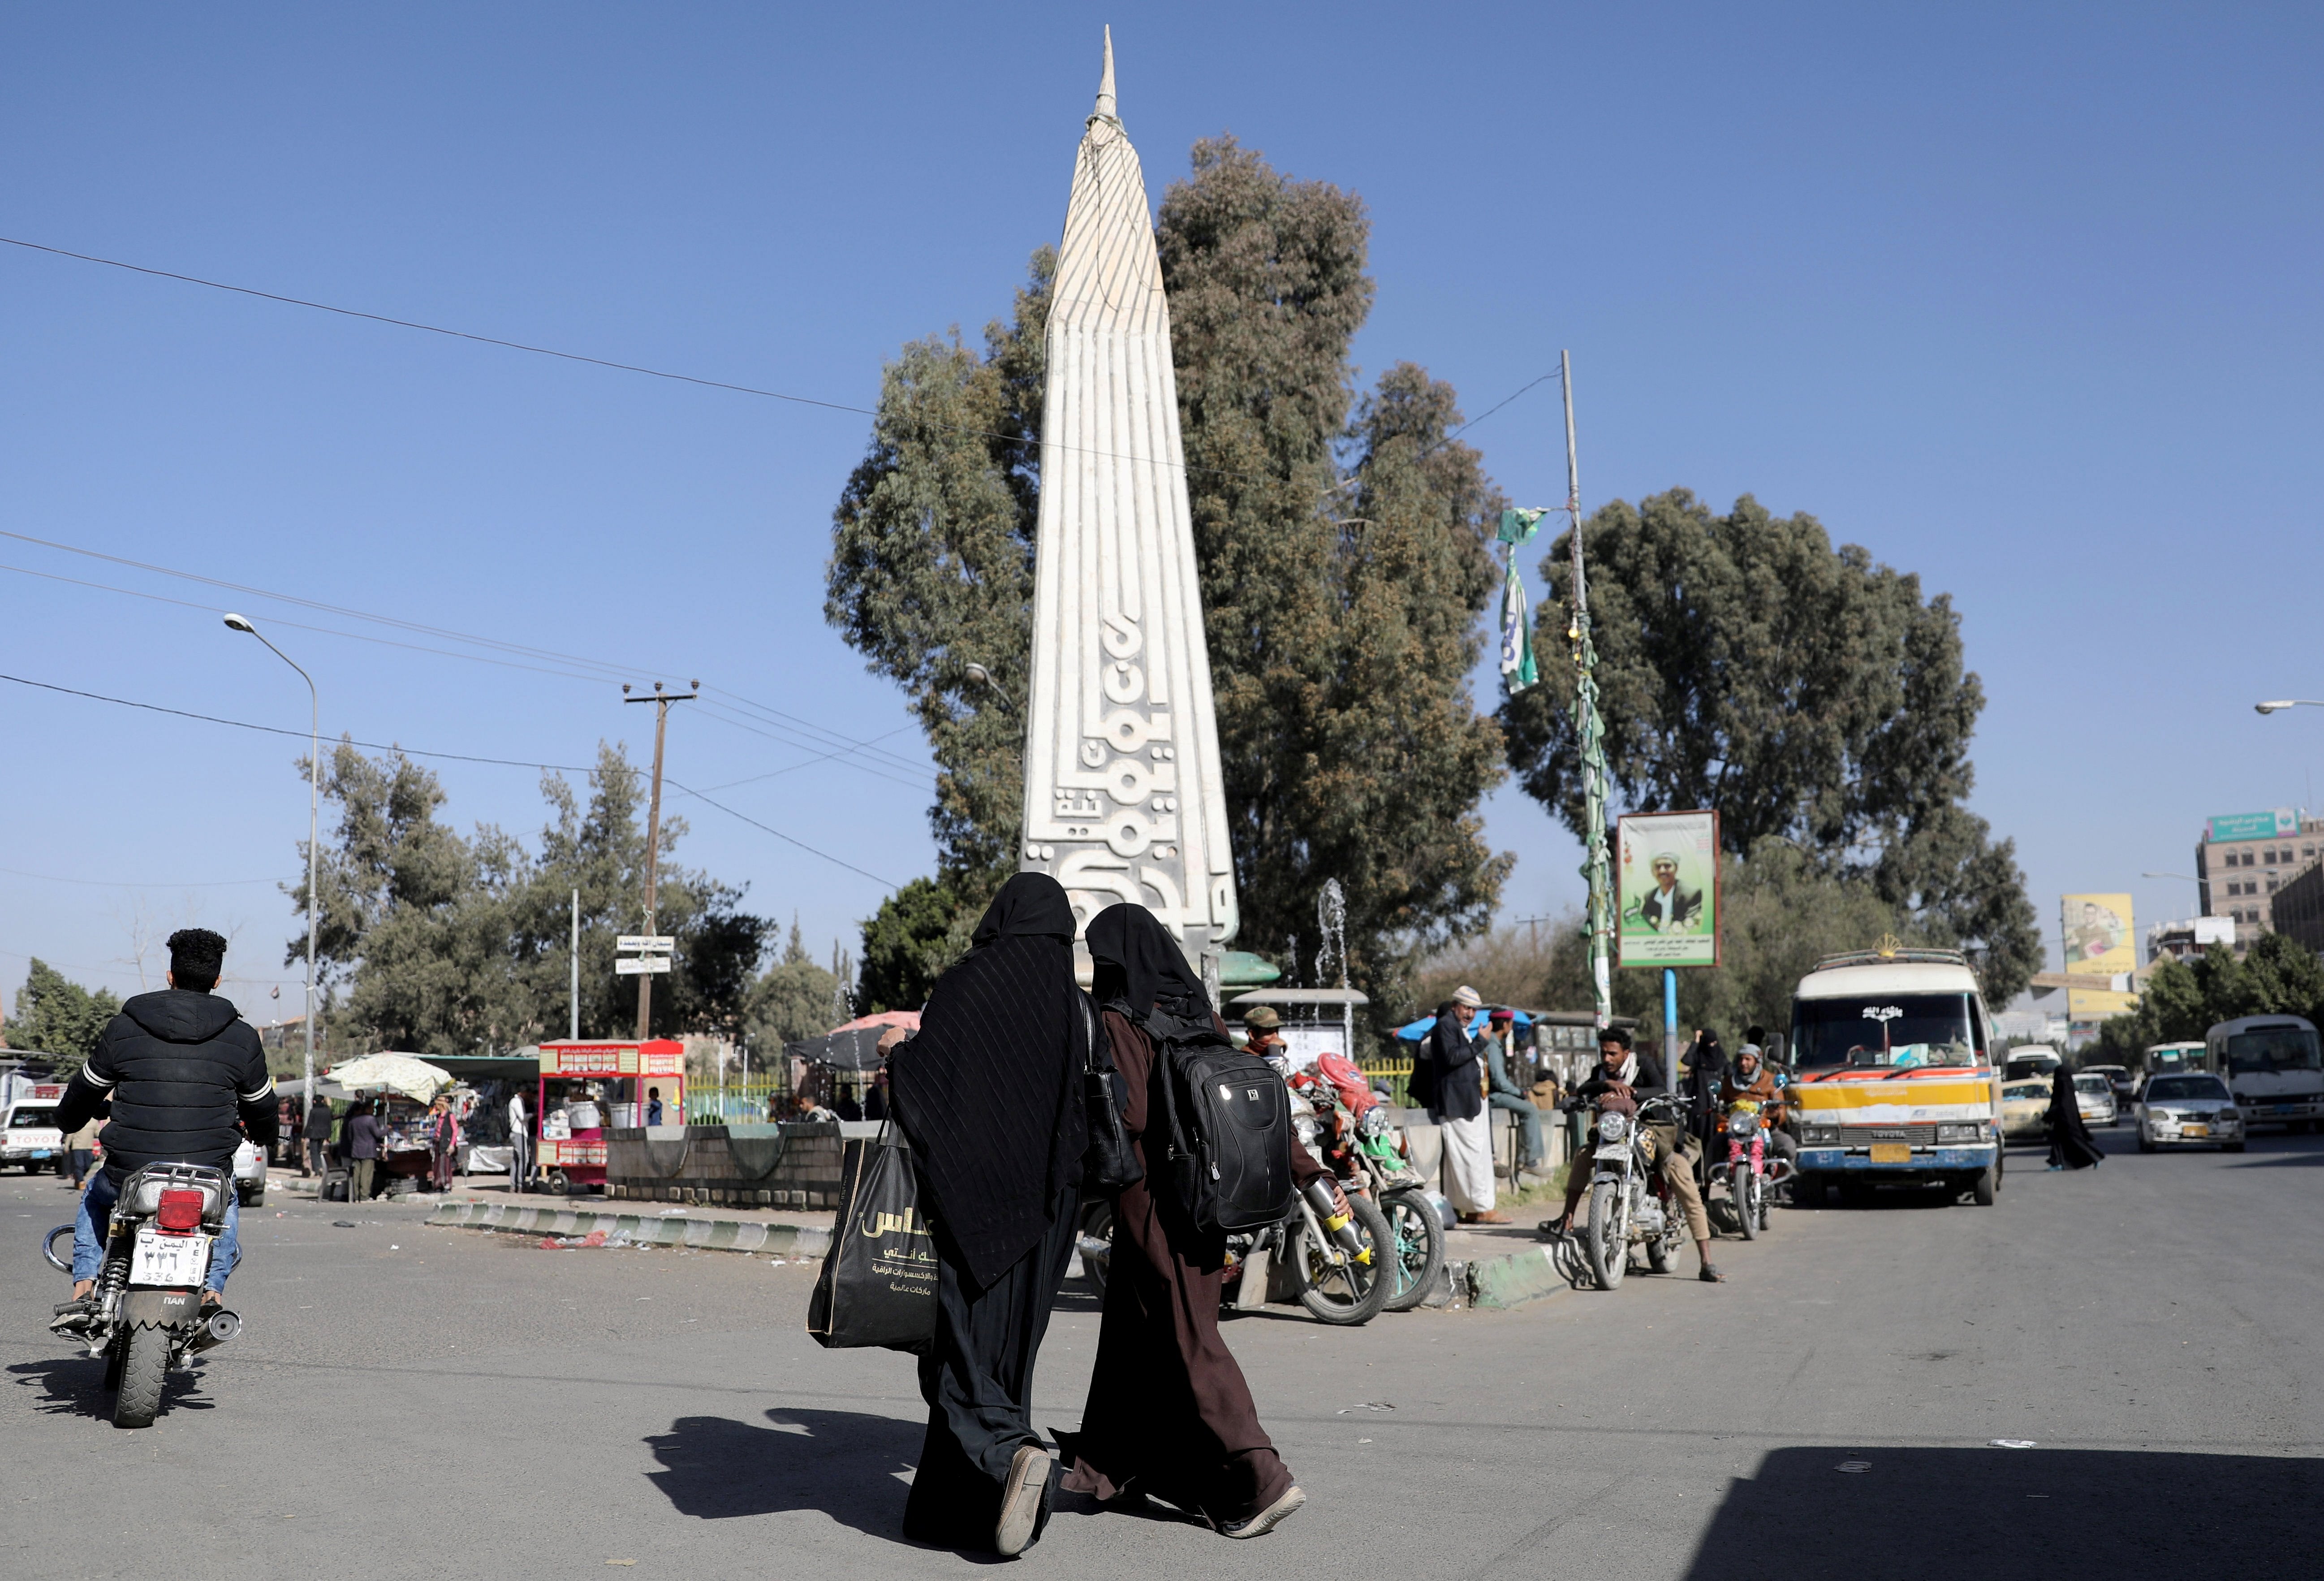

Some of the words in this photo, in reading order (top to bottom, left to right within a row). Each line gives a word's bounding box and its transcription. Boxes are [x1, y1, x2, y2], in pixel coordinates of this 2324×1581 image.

[1871, 1130, 1906, 1139] TOYOTA
[140, 1237, 154, 1248] ب
[160, 1239, 188, 1251] اليمن
[872, 1263, 893, 1275] الراقية
[890, 1282, 910, 1292] عالمية
[910, 1286, 931, 1296] ماركات
